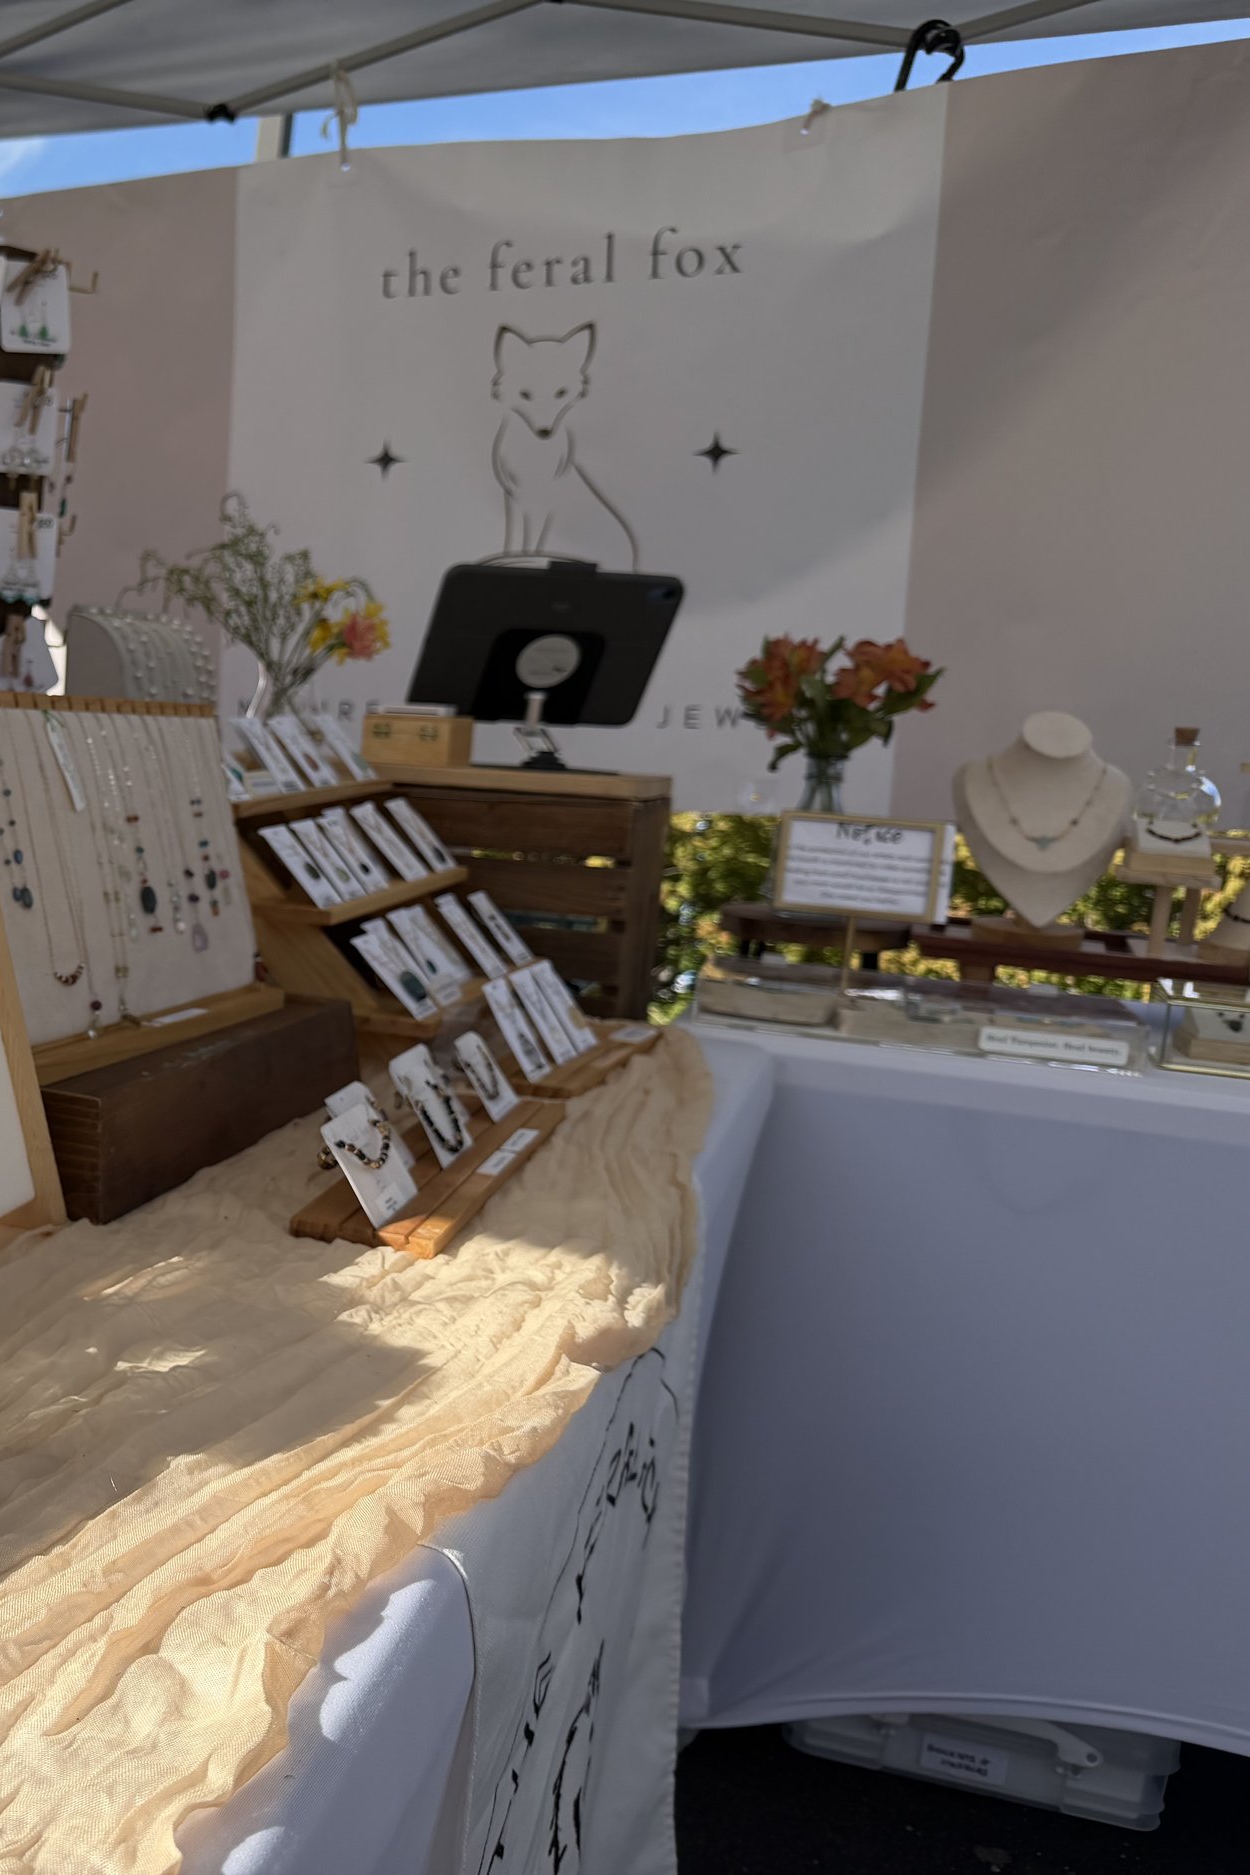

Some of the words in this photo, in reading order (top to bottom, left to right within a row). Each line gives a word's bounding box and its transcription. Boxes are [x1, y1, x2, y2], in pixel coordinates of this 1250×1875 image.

[381, 248, 463, 300] the
[488, 231, 616, 292] feral
[649, 225, 744, 281] fox
